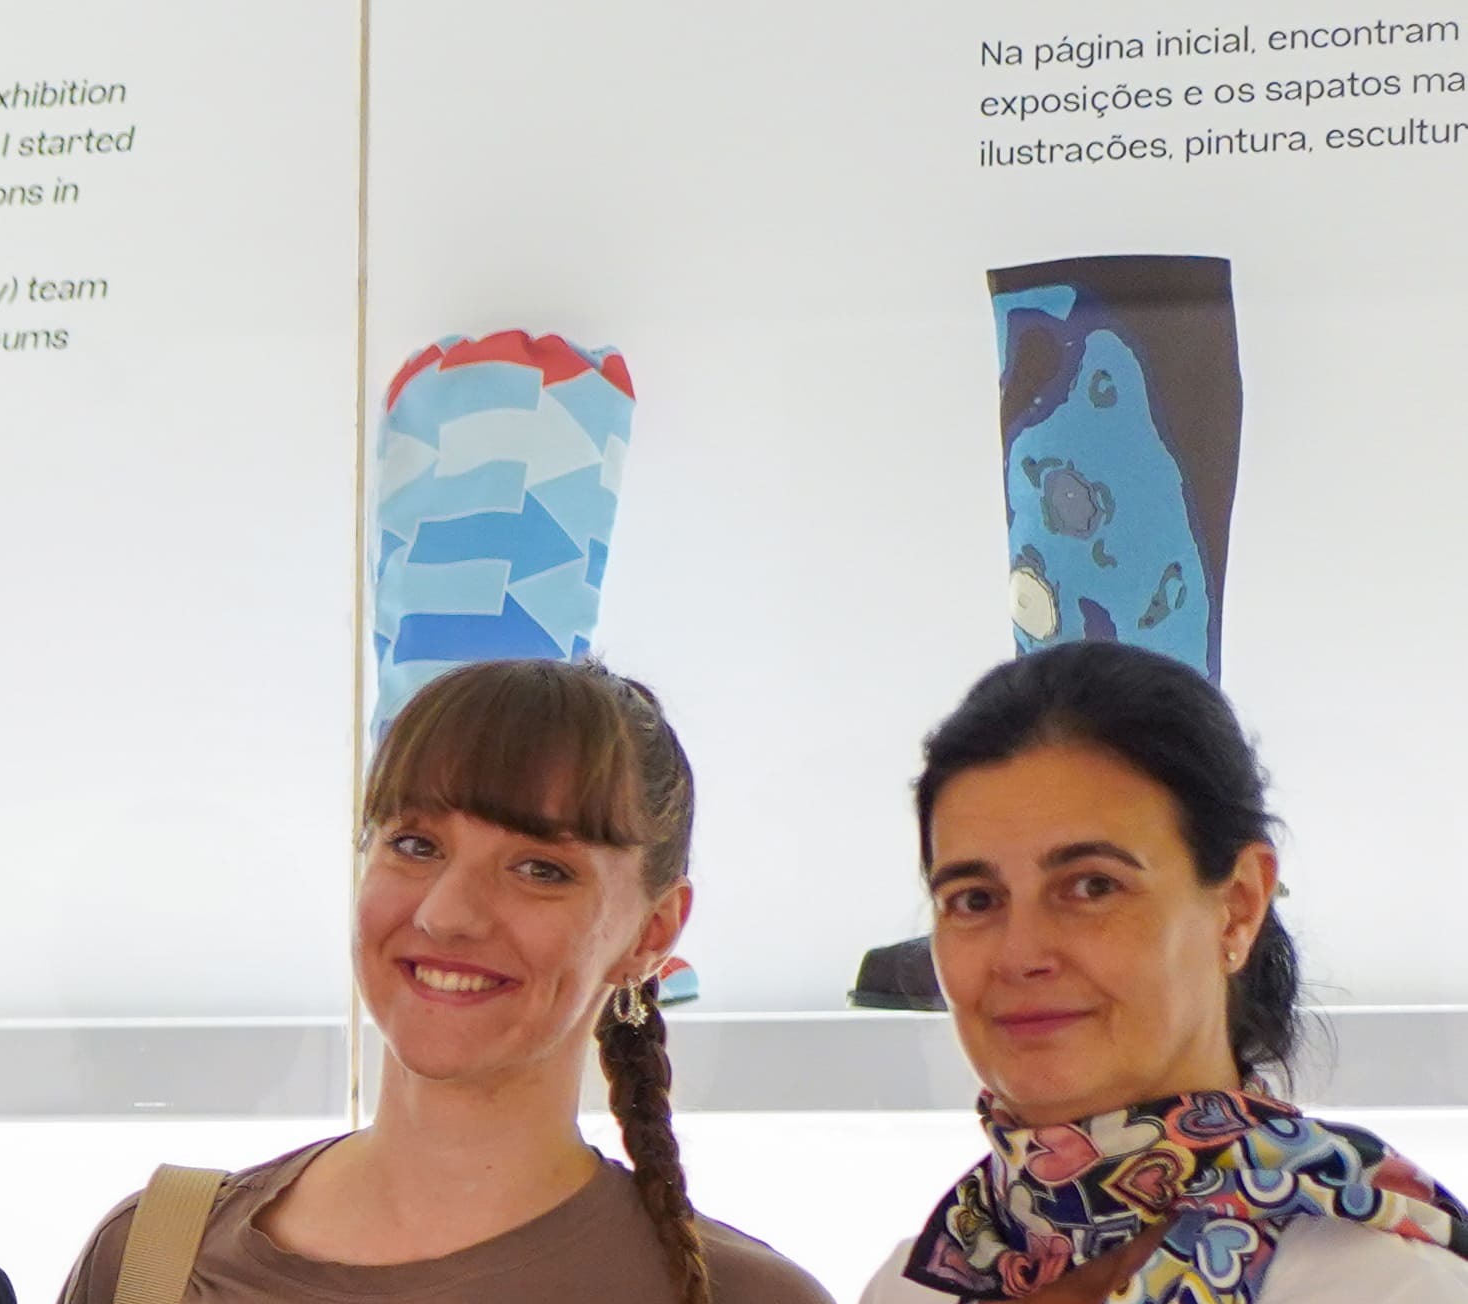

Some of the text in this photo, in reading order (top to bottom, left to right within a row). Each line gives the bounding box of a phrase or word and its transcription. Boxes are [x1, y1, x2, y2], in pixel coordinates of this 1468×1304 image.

[982, 41, 1022, 66] Na
[1035, 34, 1143, 70] página
[1268, 20, 1458, 50] encontram
[981, 84, 1172, 121] exposições
[1184, 86, 1202, 105] e
[1215, 83, 1255, 103] os
[1266, 72, 1401, 106] sapatos
[17, 124, 137, 158] started
[52, 176, 81, 205] in
[27, 275, 109, 303] team
